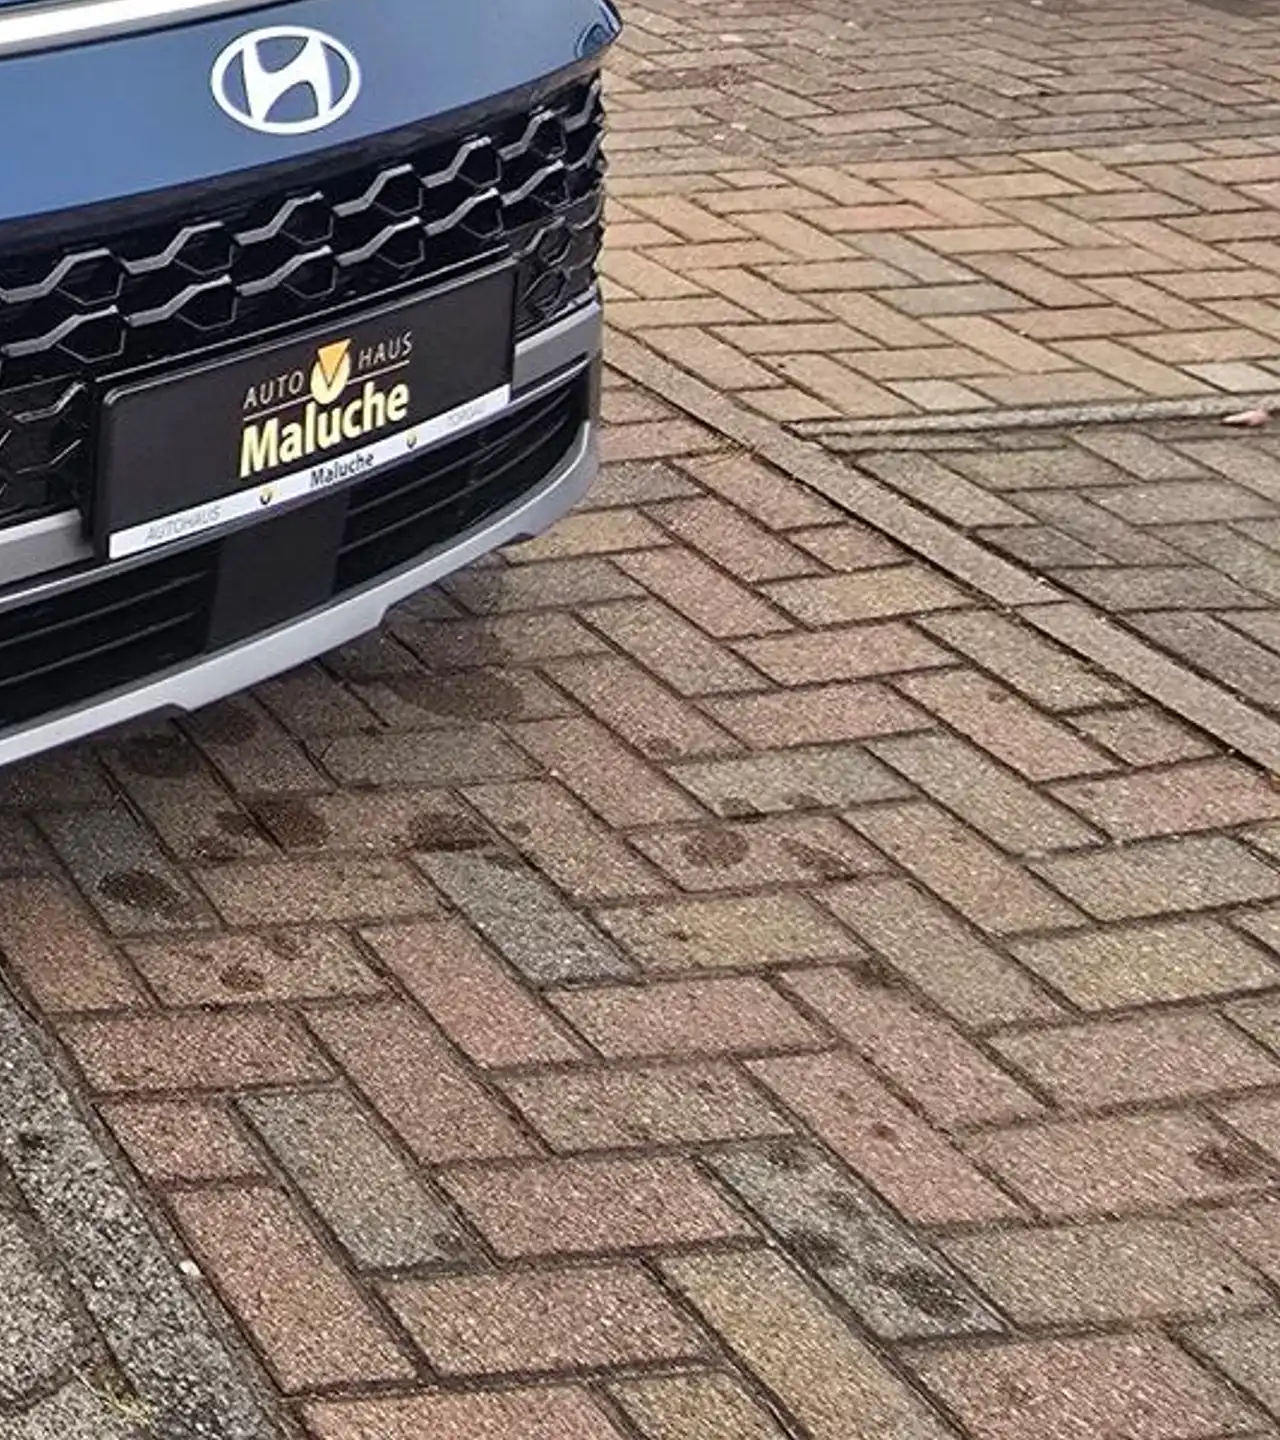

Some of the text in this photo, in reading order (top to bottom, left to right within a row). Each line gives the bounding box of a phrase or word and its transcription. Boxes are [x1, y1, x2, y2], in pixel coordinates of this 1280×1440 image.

[243, 331, 413, 410] AUTO HAUS
[239, 381, 410, 478] Maluche
[309, 451, 375, 488] Maluche
